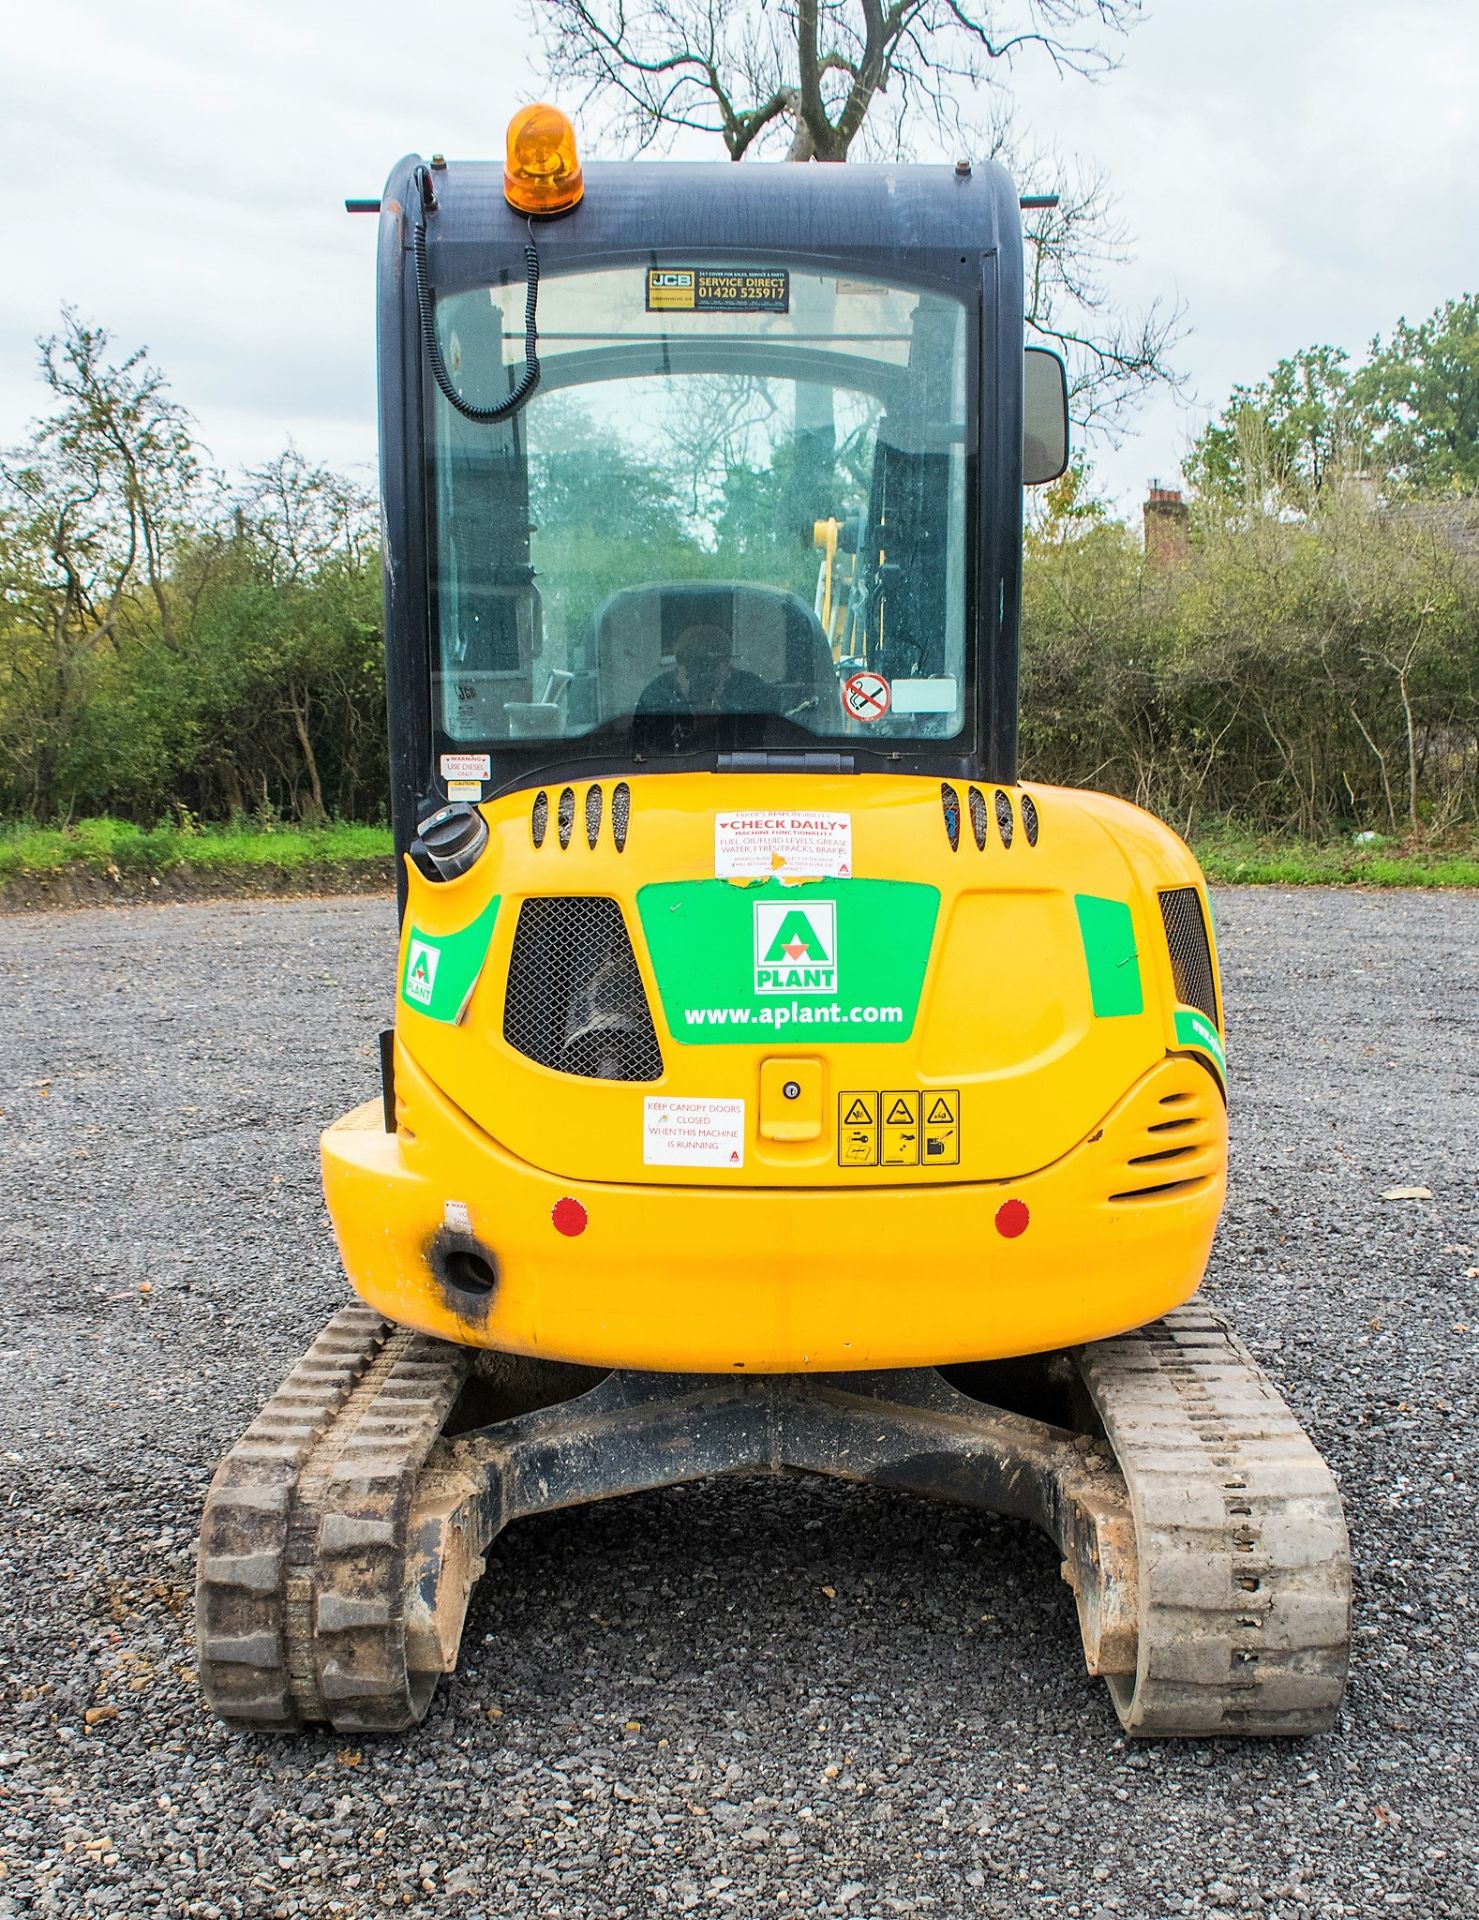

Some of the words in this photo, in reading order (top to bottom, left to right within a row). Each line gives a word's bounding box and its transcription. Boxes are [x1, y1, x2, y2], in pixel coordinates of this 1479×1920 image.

[653, 274, 691, 286] JCB
[699, 277, 743, 287] SERVICE
[746, 278, 785, 287] DIRECT
[699, 287, 737, 298] 01420
[740, 288, 785, 298] 525917
[730, 819, 785, 830] CHECK
[791, 819, 837, 831] DAILY
[757, 969, 835, 988] PLANT
[684, 1001, 903, 1029] www.aplant.com
[669, 1103, 707, 1112] CANOPY
[709, 1104, 741, 1113] DOORS
[677, 1116, 711, 1125] CLOSED
[649, 1127, 676, 1136] WHEN
[678, 1128, 696, 1137] THIS
[699, 1129, 739, 1137] MACHINE
[668, 1140, 675, 1148] IS
[676, 1141, 719, 1150] RUNNING
